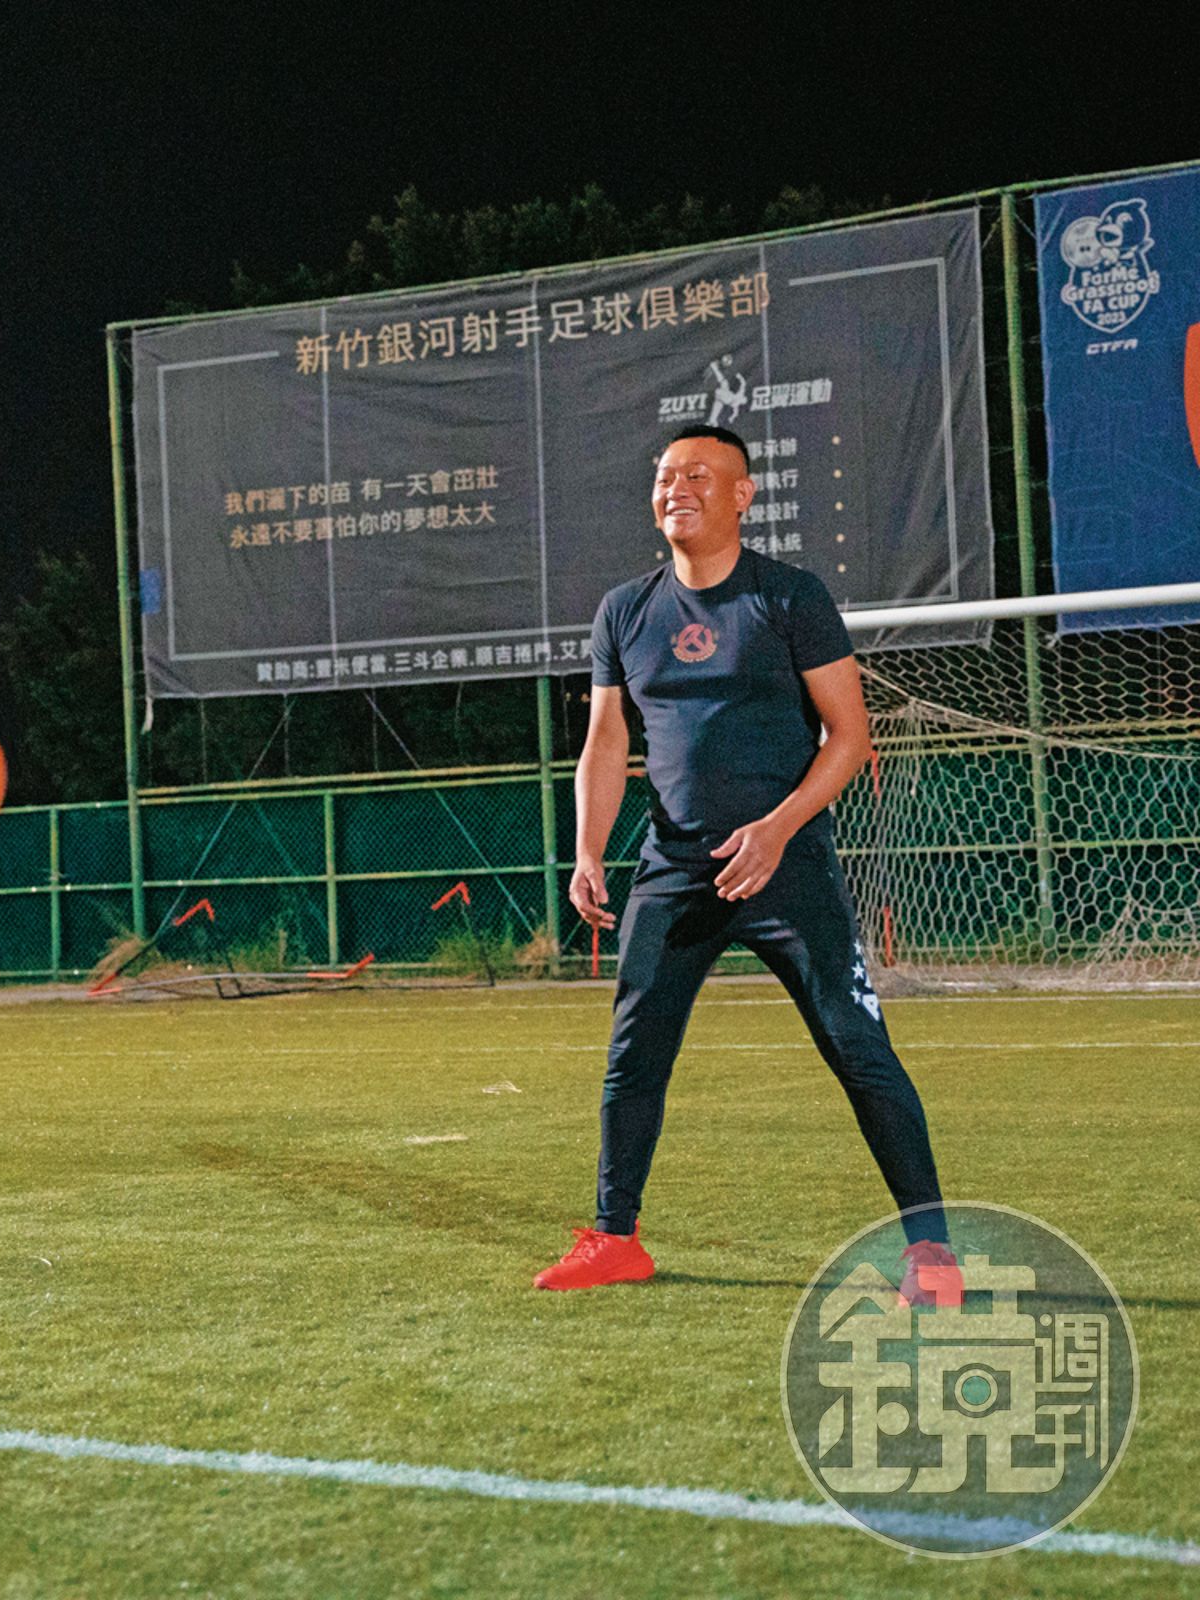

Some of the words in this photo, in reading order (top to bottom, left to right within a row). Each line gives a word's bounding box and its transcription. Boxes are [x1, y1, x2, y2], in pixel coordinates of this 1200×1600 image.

[1081, 266, 1140, 287] ForMe
[1064, 275, 1158, 302] Grassroot
[1082, 299, 1105, 314] FA
[1108, 294, 1141, 310] CUP
[295, 271, 770, 376] 新竹銀河射手足球俱樂部
[1086, 338, 1139, 355] CTFA
[658, 393, 708, 415] ZUYI
[229, 500, 497, 549] 永遠不要害怕你的夢想太大
